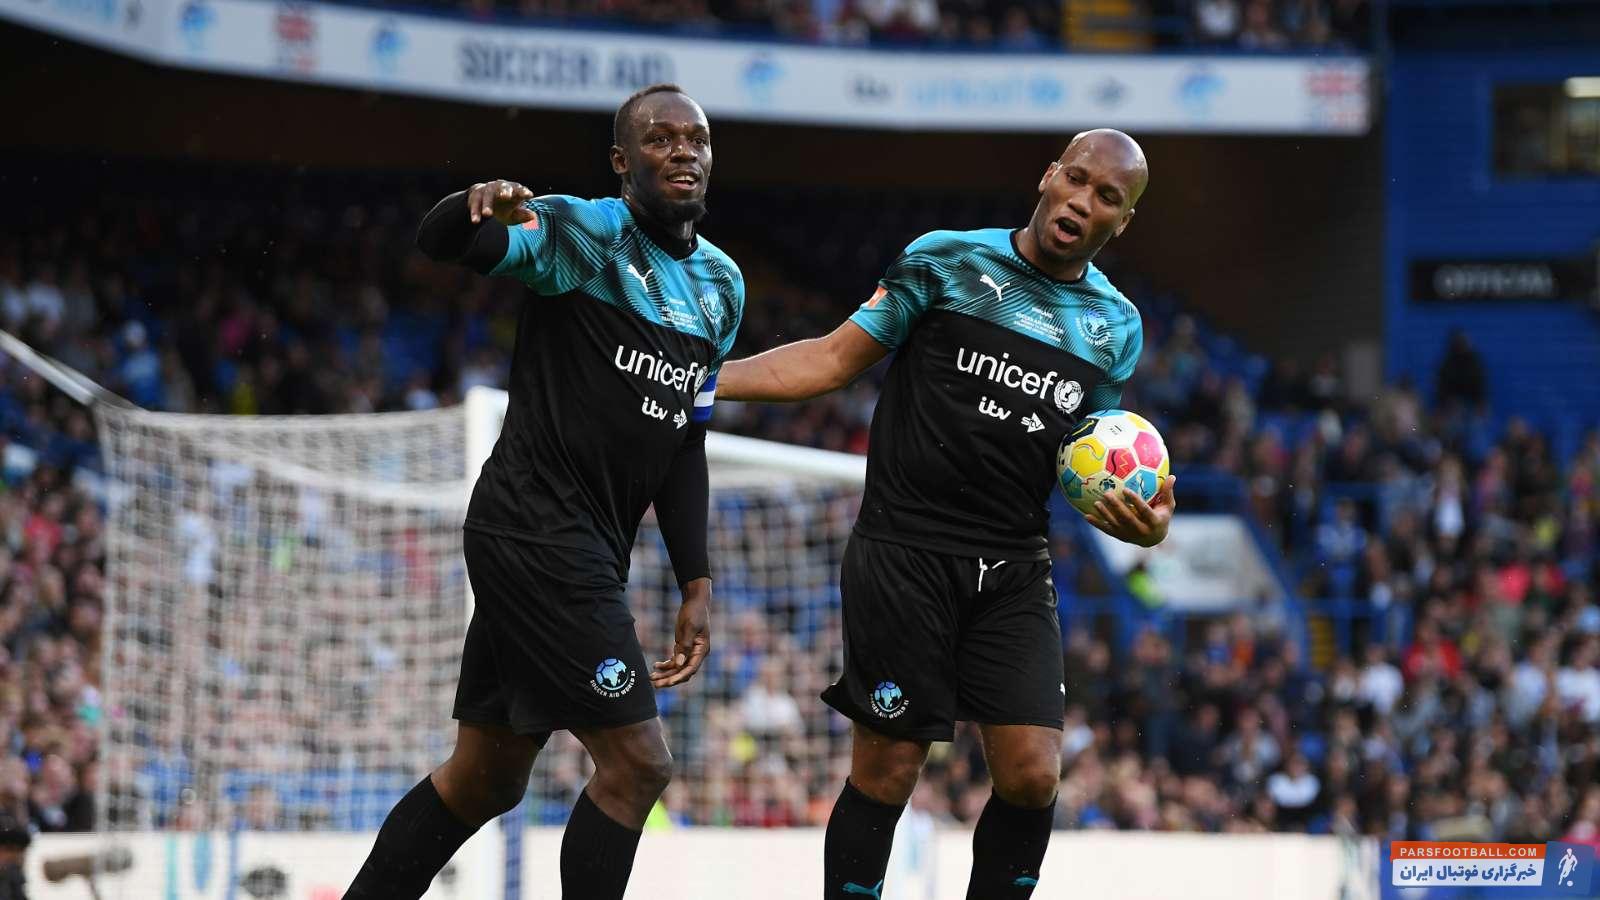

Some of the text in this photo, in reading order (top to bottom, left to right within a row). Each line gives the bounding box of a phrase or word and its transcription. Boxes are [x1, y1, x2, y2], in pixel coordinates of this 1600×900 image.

[459, 41, 599, 88] SOCCER
[614, 345, 698, 393] unicef
[956, 347, 1059, 400] unicef
[641, 396, 669, 420] itv
[978, 396, 1012, 420] itv
[589, 679, 607, 697] SOCCER
